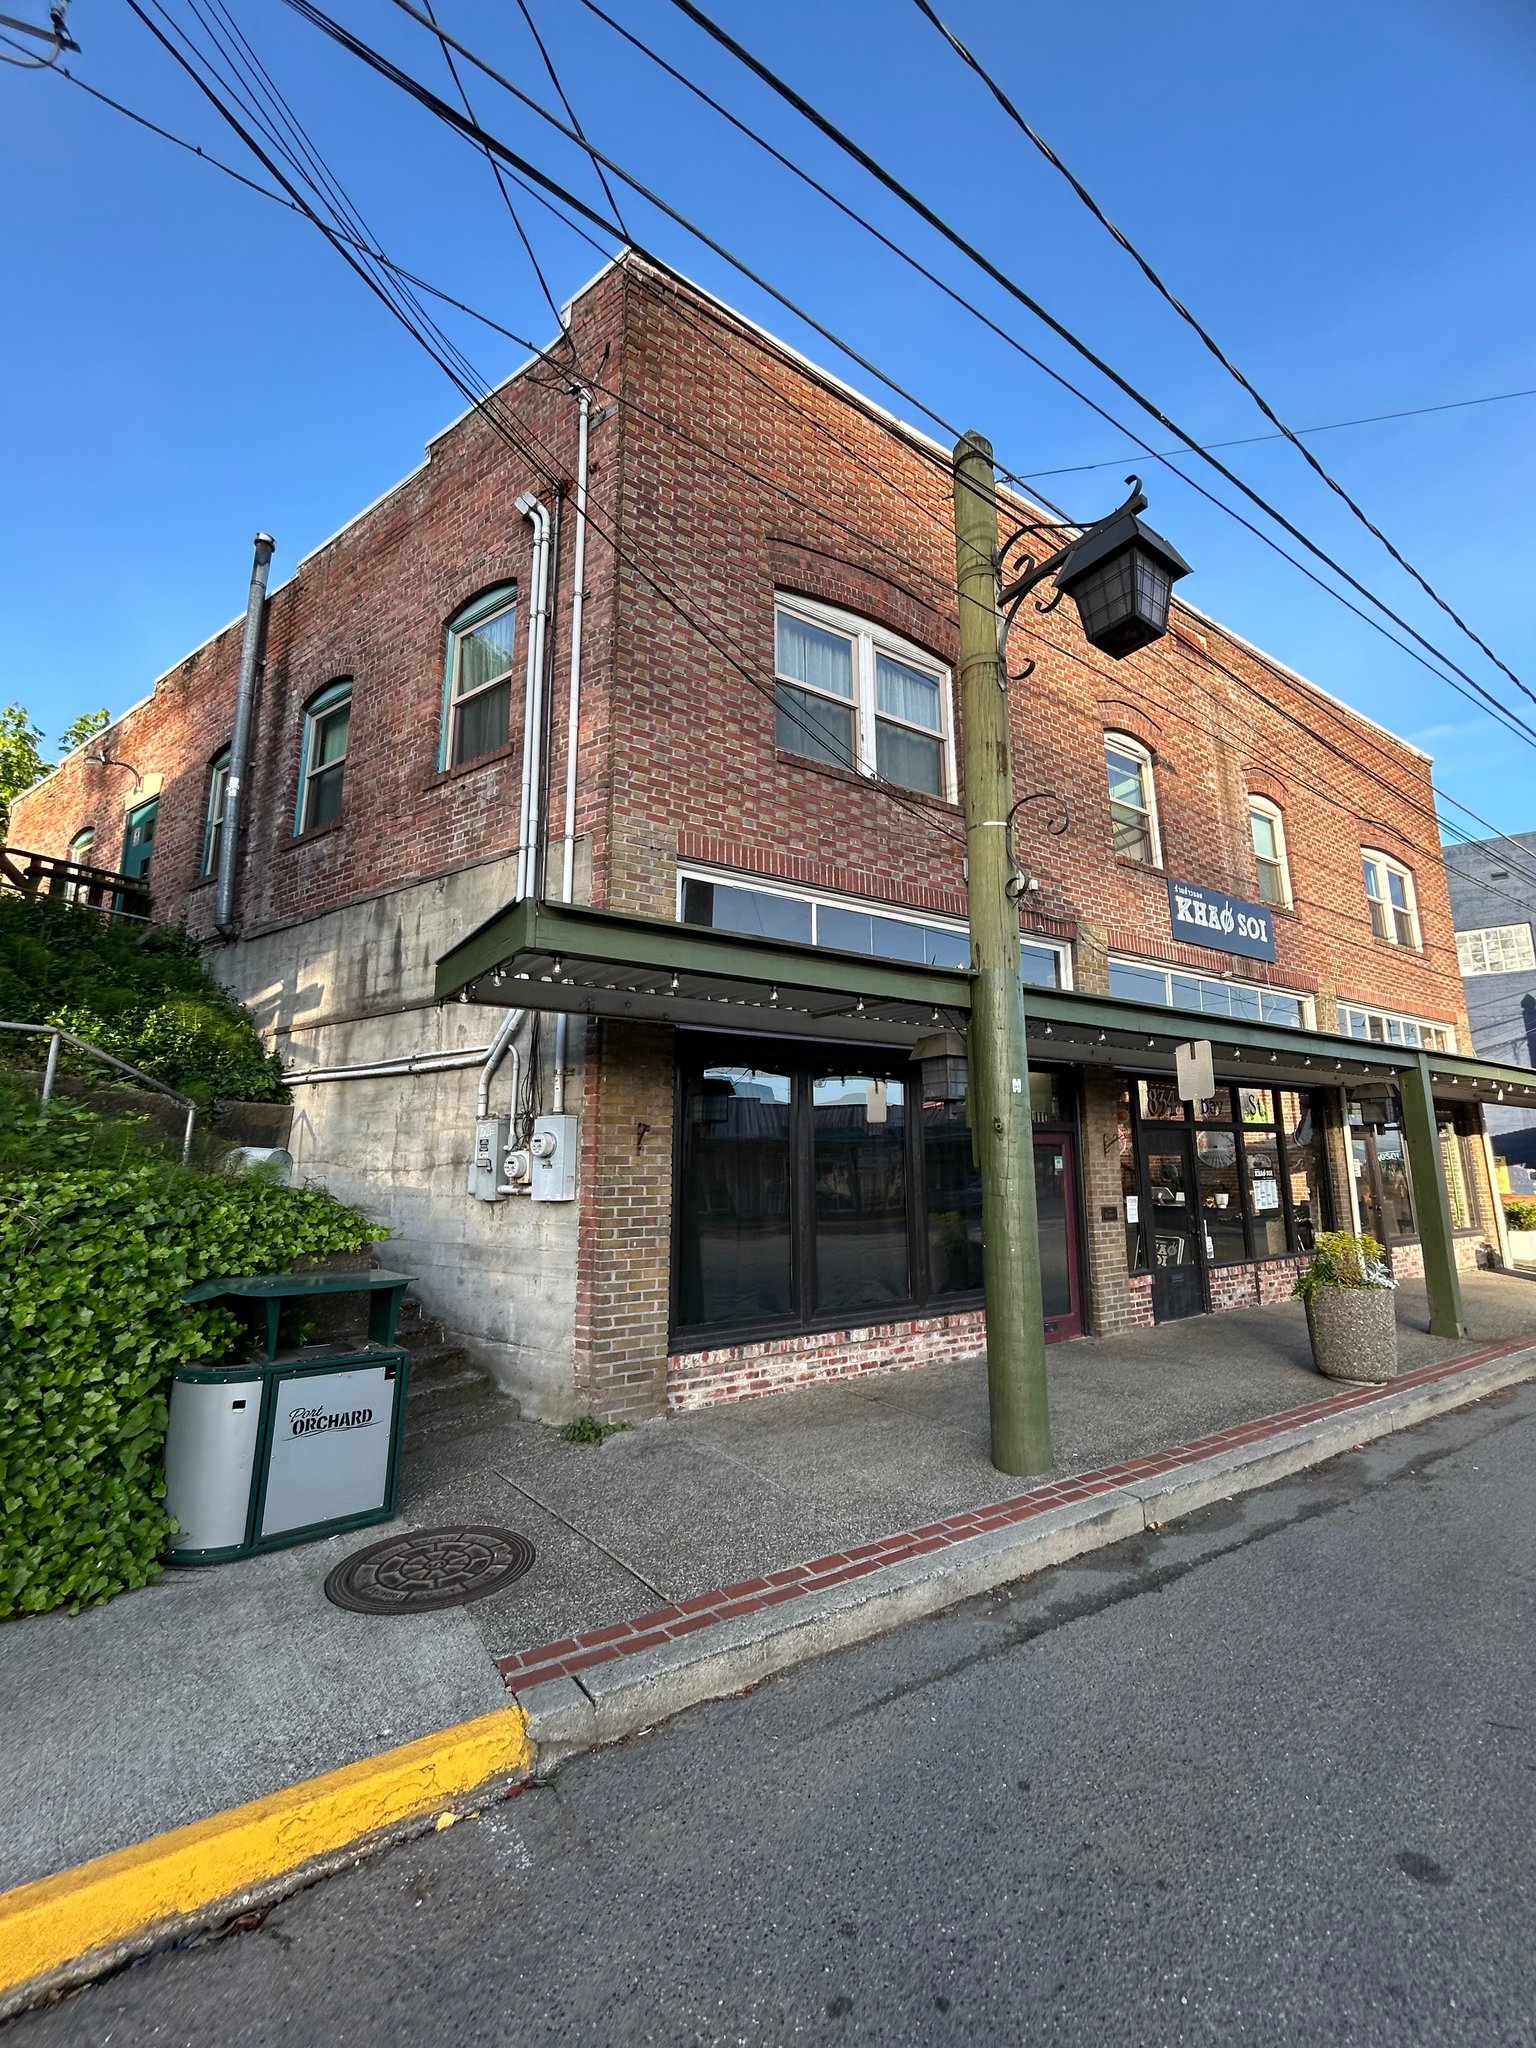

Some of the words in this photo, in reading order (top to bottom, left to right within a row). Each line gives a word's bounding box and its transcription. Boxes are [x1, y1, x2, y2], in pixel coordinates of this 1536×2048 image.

[1175, 895, 1235, 935] KHAO
[1237, 913, 1268, 943] SOI
[1147, 1088, 1178, 1117] 834
[289, 1405, 324, 1423] Port
[292, 1408, 373, 1435] ORCHARD
